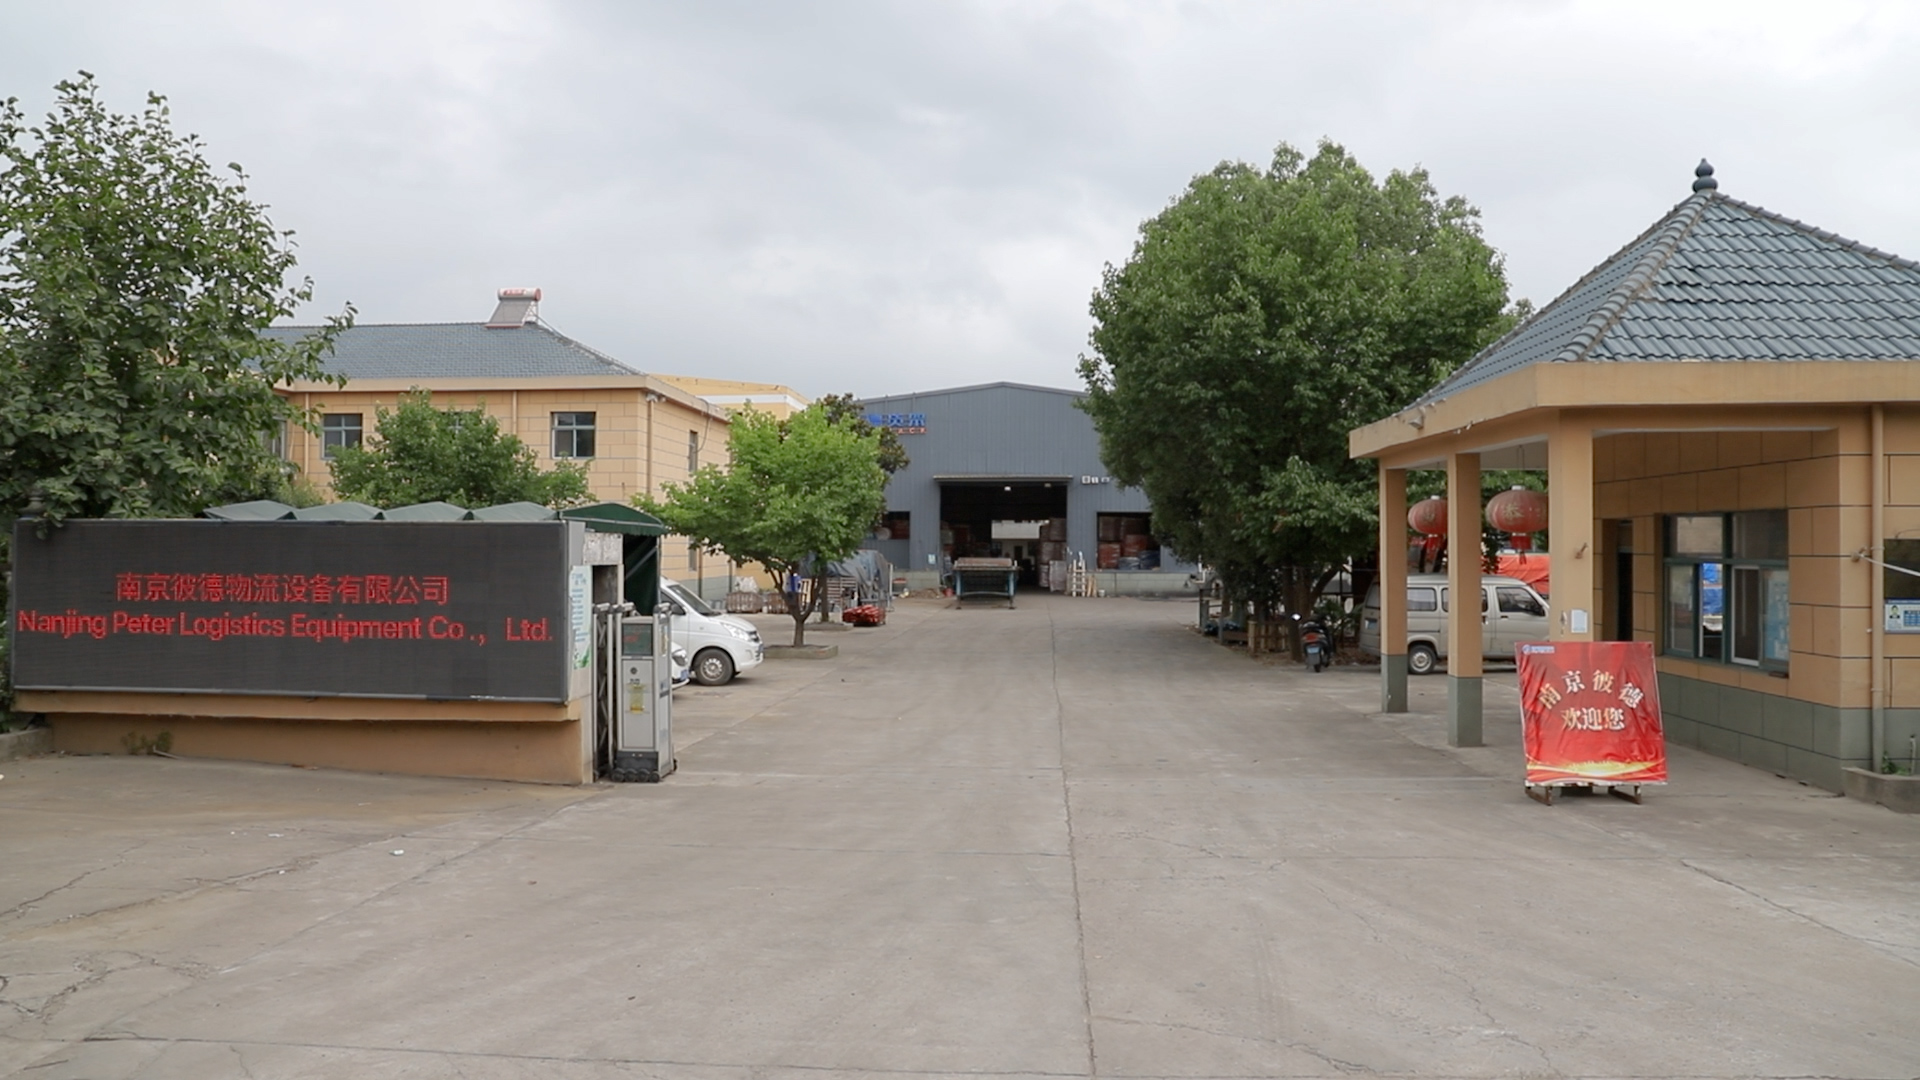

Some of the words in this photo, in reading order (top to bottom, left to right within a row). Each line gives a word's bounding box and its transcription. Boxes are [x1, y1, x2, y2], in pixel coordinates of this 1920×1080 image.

[116, 572, 449, 605] 南京彼德物流设备有限公司
[18, 610, 107, 639] Nanjing
[113, 611, 176, 634] Peter
[179, 612, 286, 641] Logistics
[291, 614, 423, 643] Equipment
[506, 618, 553, 641] Ltd.
[1537, 669, 1645, 710] 南京彼德
[1560, 706, 1626, 731] 欢迎您
